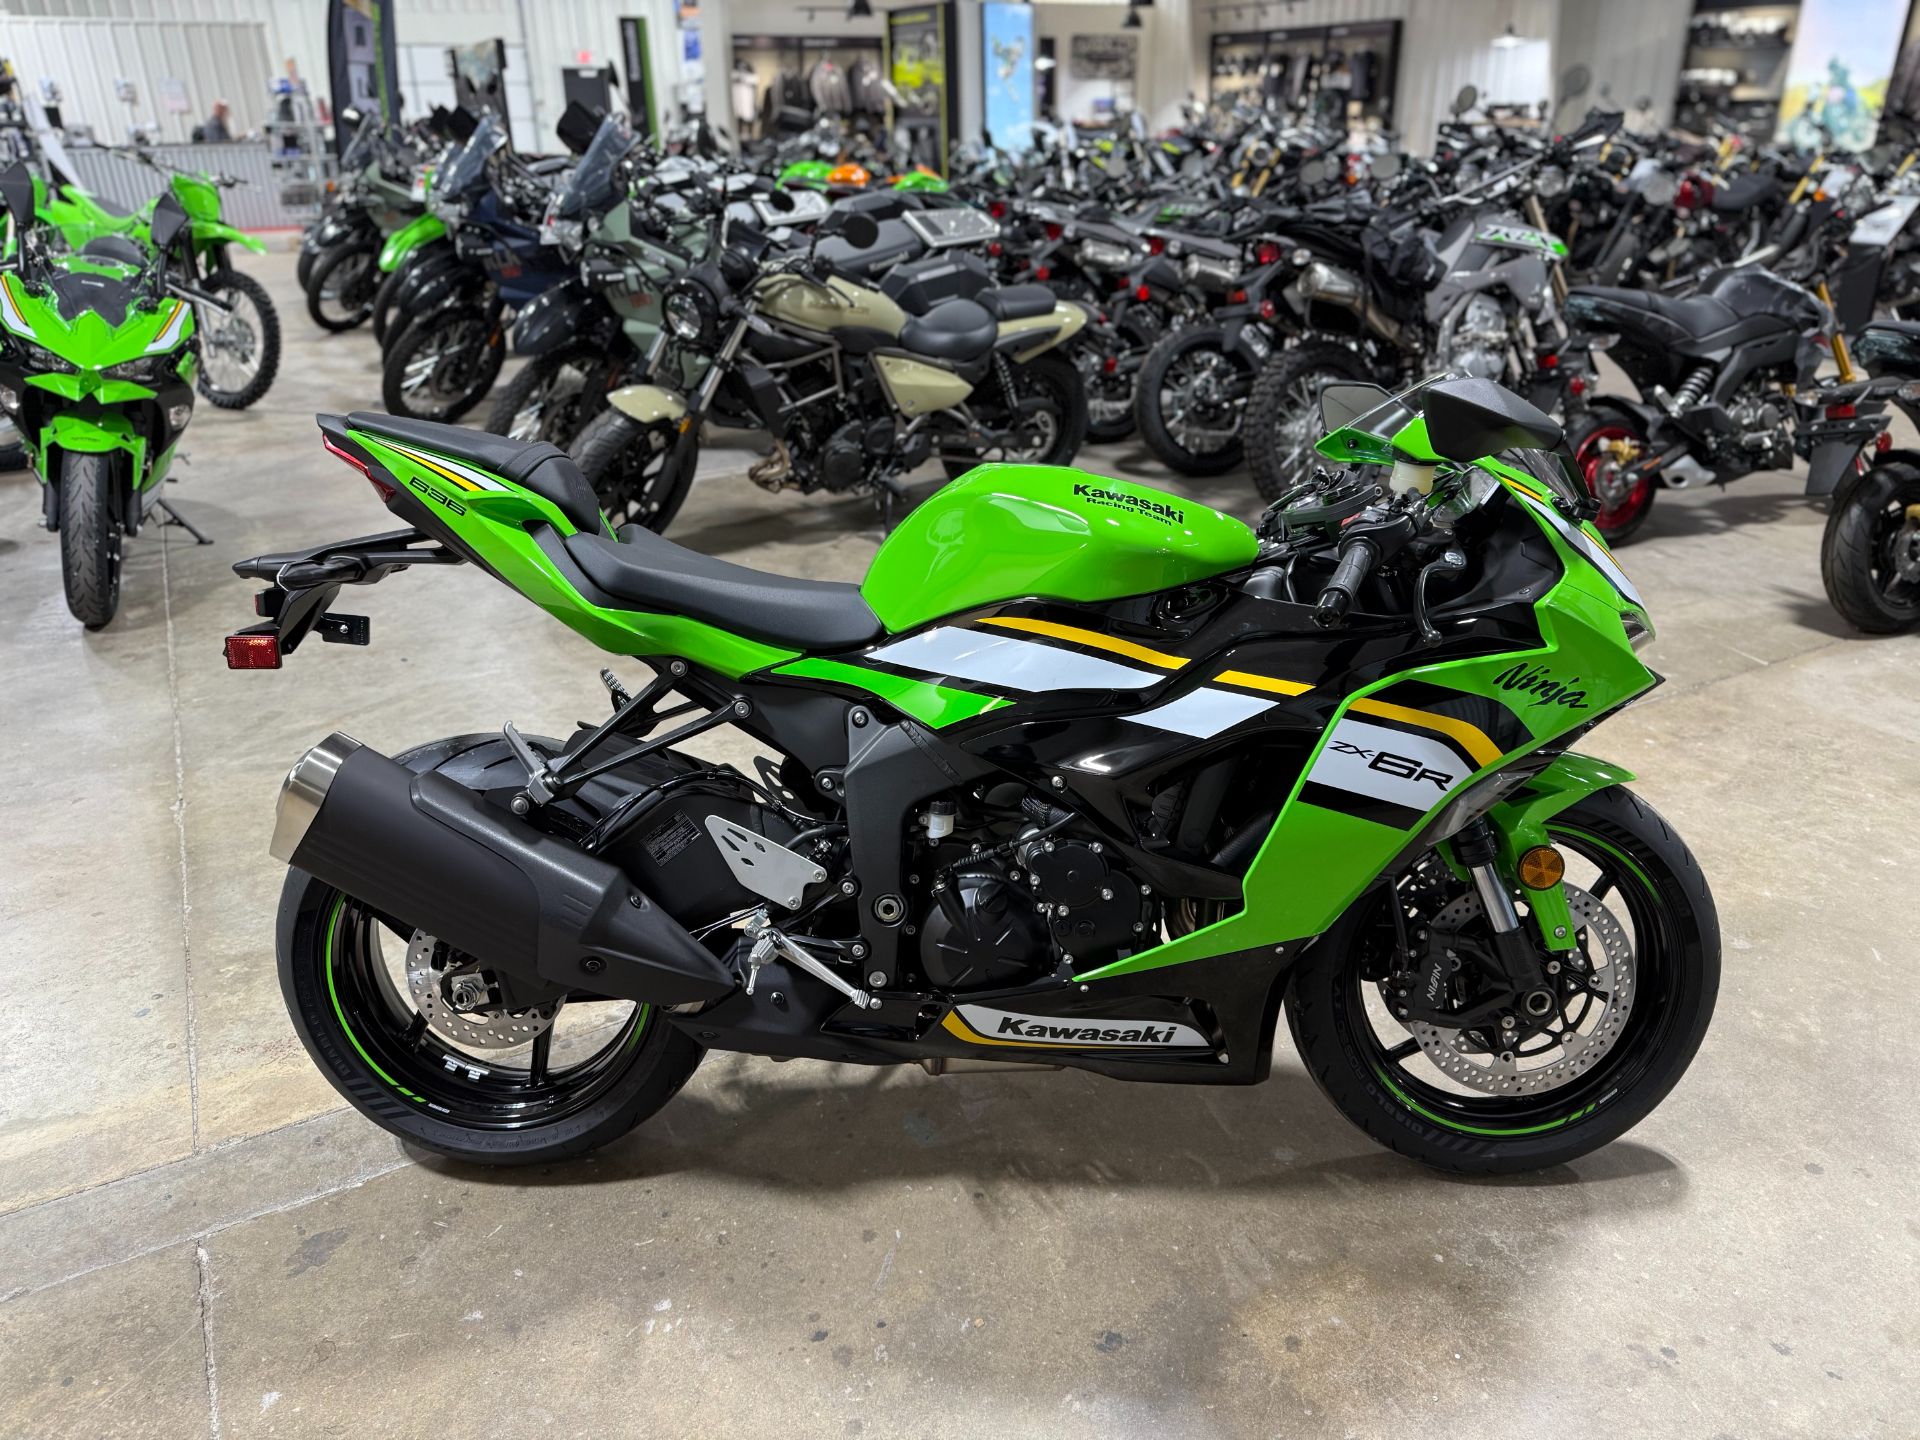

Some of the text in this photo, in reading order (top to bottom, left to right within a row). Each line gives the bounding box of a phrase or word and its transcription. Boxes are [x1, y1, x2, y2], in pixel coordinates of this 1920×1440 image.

[409, 476, 467, 516] 636
[1073, 484, 1184, 524] Kawasaki
[1086, 497, 1173, 526] Racing Team
[1492, 662, 1589, 708] Ninja
[1328, 740, 1454, 791] ZX-6R
[1426, 962, 1442, 1001] NISSIN
[997, 1016, 1178, 1043] Kawasaki
